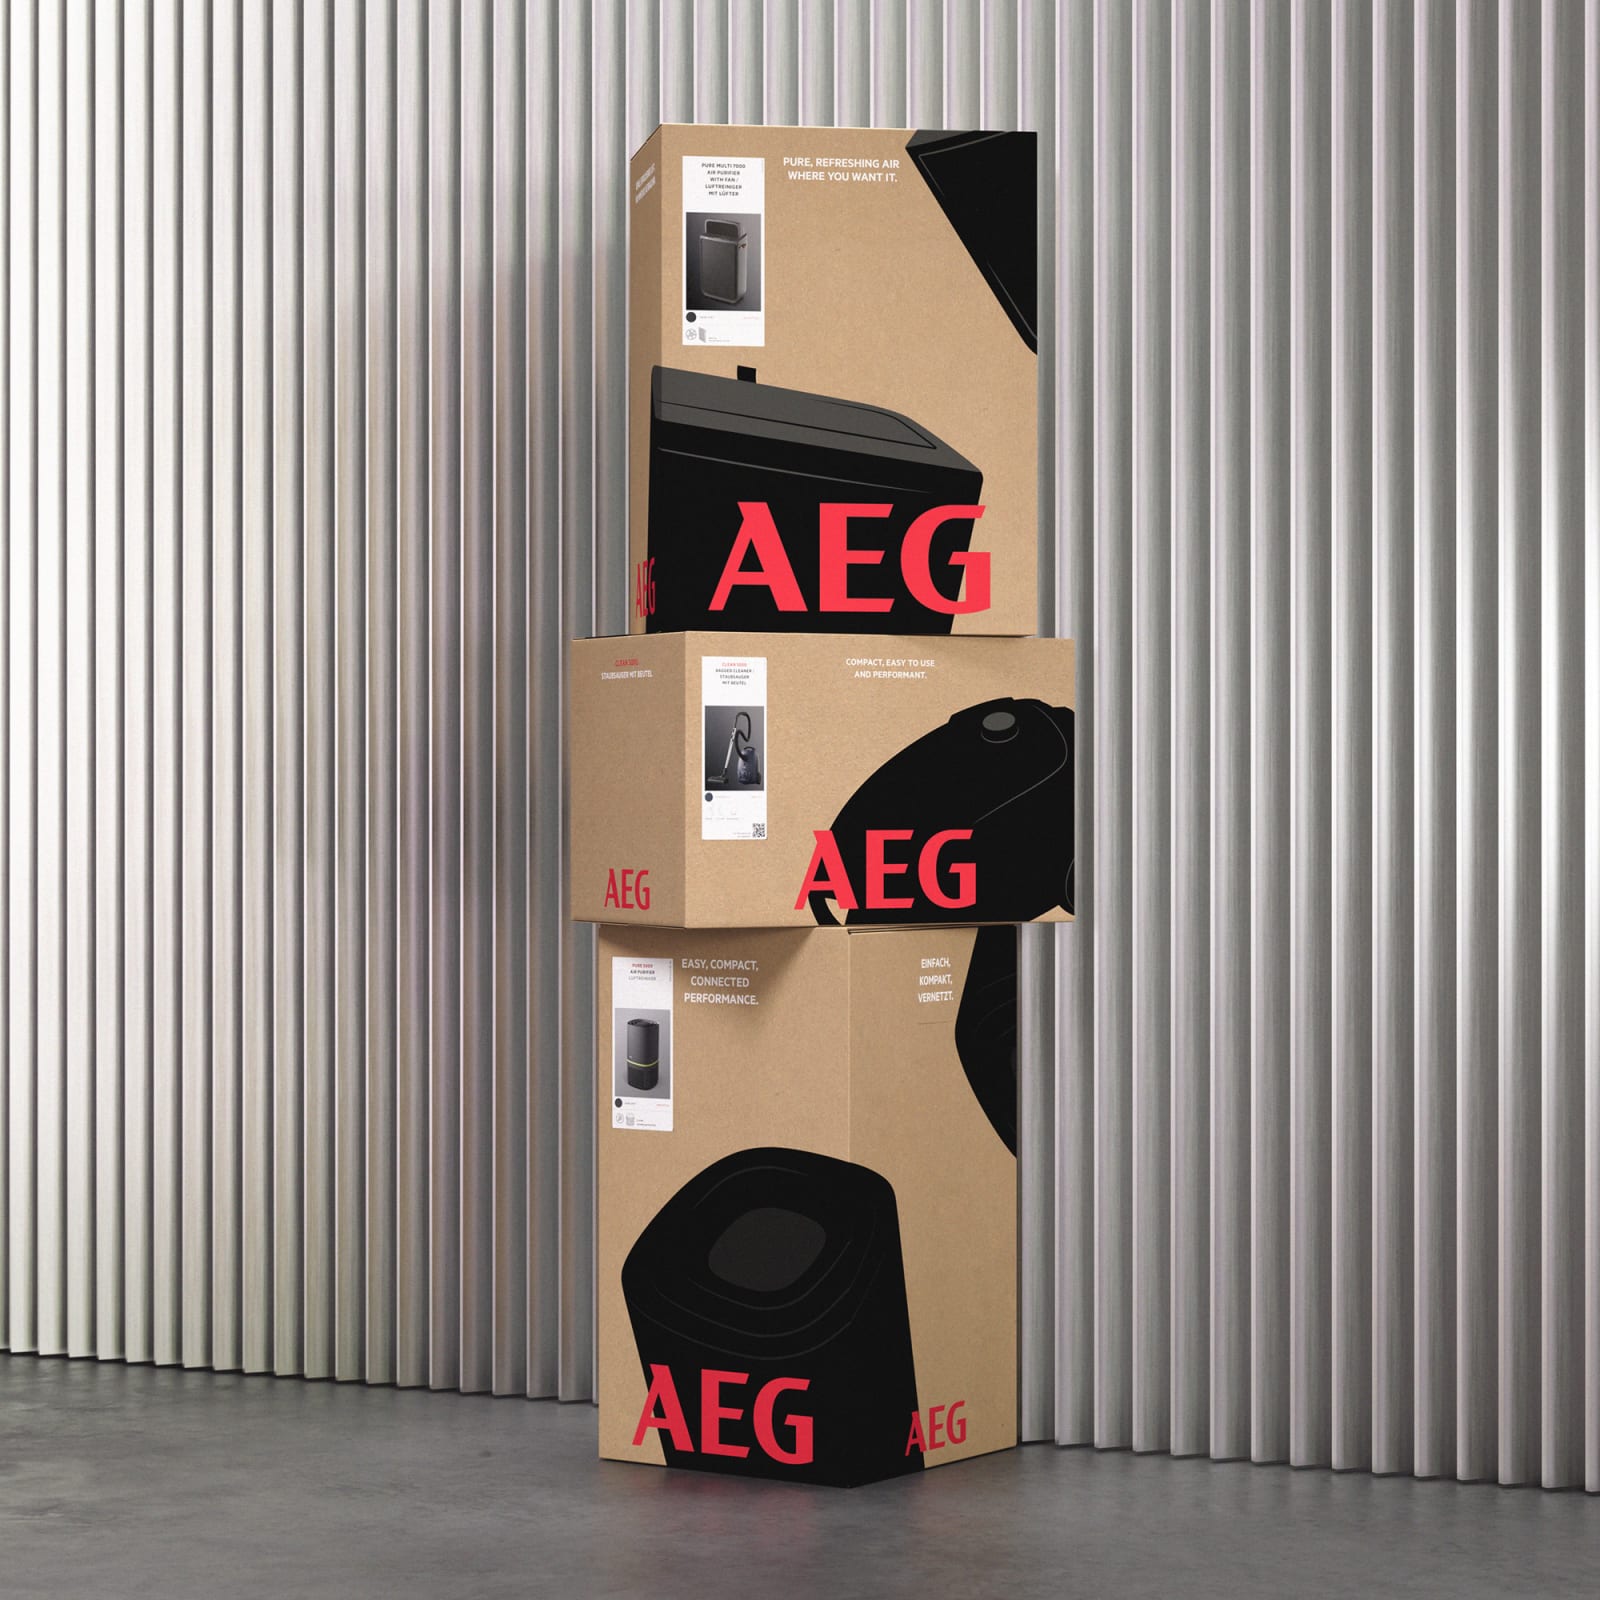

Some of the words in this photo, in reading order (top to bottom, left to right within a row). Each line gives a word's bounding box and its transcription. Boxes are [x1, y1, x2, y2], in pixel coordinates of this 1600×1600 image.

[783, 157, 813, 168] PURE,
[815, 158, 880, 169] REFRESHING
[881, 159, 900, 169] AIR
[787, 170, 825, 181] WHERE
[827, 171, 850, 182] YOU
[851, 172, 882, 182] WANT
[885, 173, 898, 183] IT.
[709, 502, 991, 616] AEG
[636, 557, 656, 618] AEG
[846, 658, 885, 668] COMPACT,
[886, 659, 908, 667] EASY
[909, 659, 919, 667] TO
[920, 659, 935, 667] USE
[854, 670, 872, 679] AND
[873, 671, 928, 680] PERFORMANT.
[794, 830, 977, 910] AEG
[605, 868, 650, 910] AEG
[681, 958, 709, 971] EASY,
[710, 959, 759, 972] COMPACT,
[691, 975, 749, 988] CONNECTED
[684, 993, 759, 1005] PERFORMANCE.
[918, 991, 954, 1003] VERNETZT.
[632, 1364, 814, 1465] AEG
[905, 1400, 967, 1456] AEG
